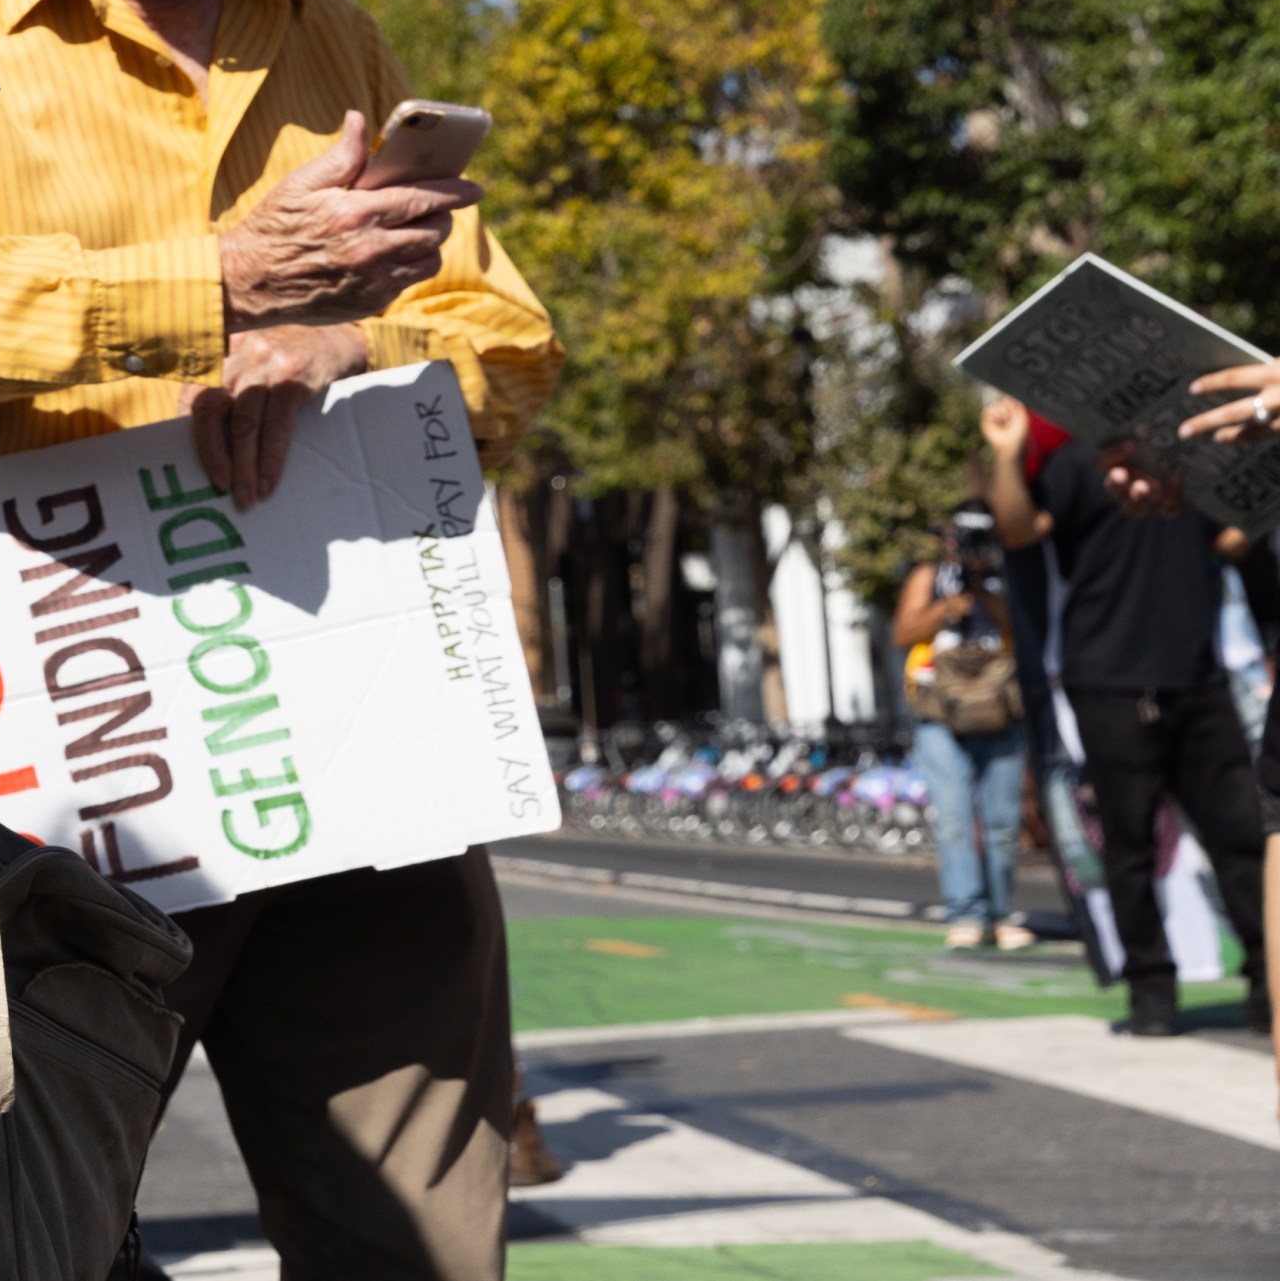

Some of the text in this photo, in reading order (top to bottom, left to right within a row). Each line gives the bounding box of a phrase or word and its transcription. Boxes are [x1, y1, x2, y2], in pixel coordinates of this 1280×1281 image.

[414, 395, 458, 461] FOR
[429, 477, 474, 538] PAY
[2, 483, 200, 884] FUNDING
[475, 655, 519, 741] WHAT
[497, 756, 541, 818] SAY
